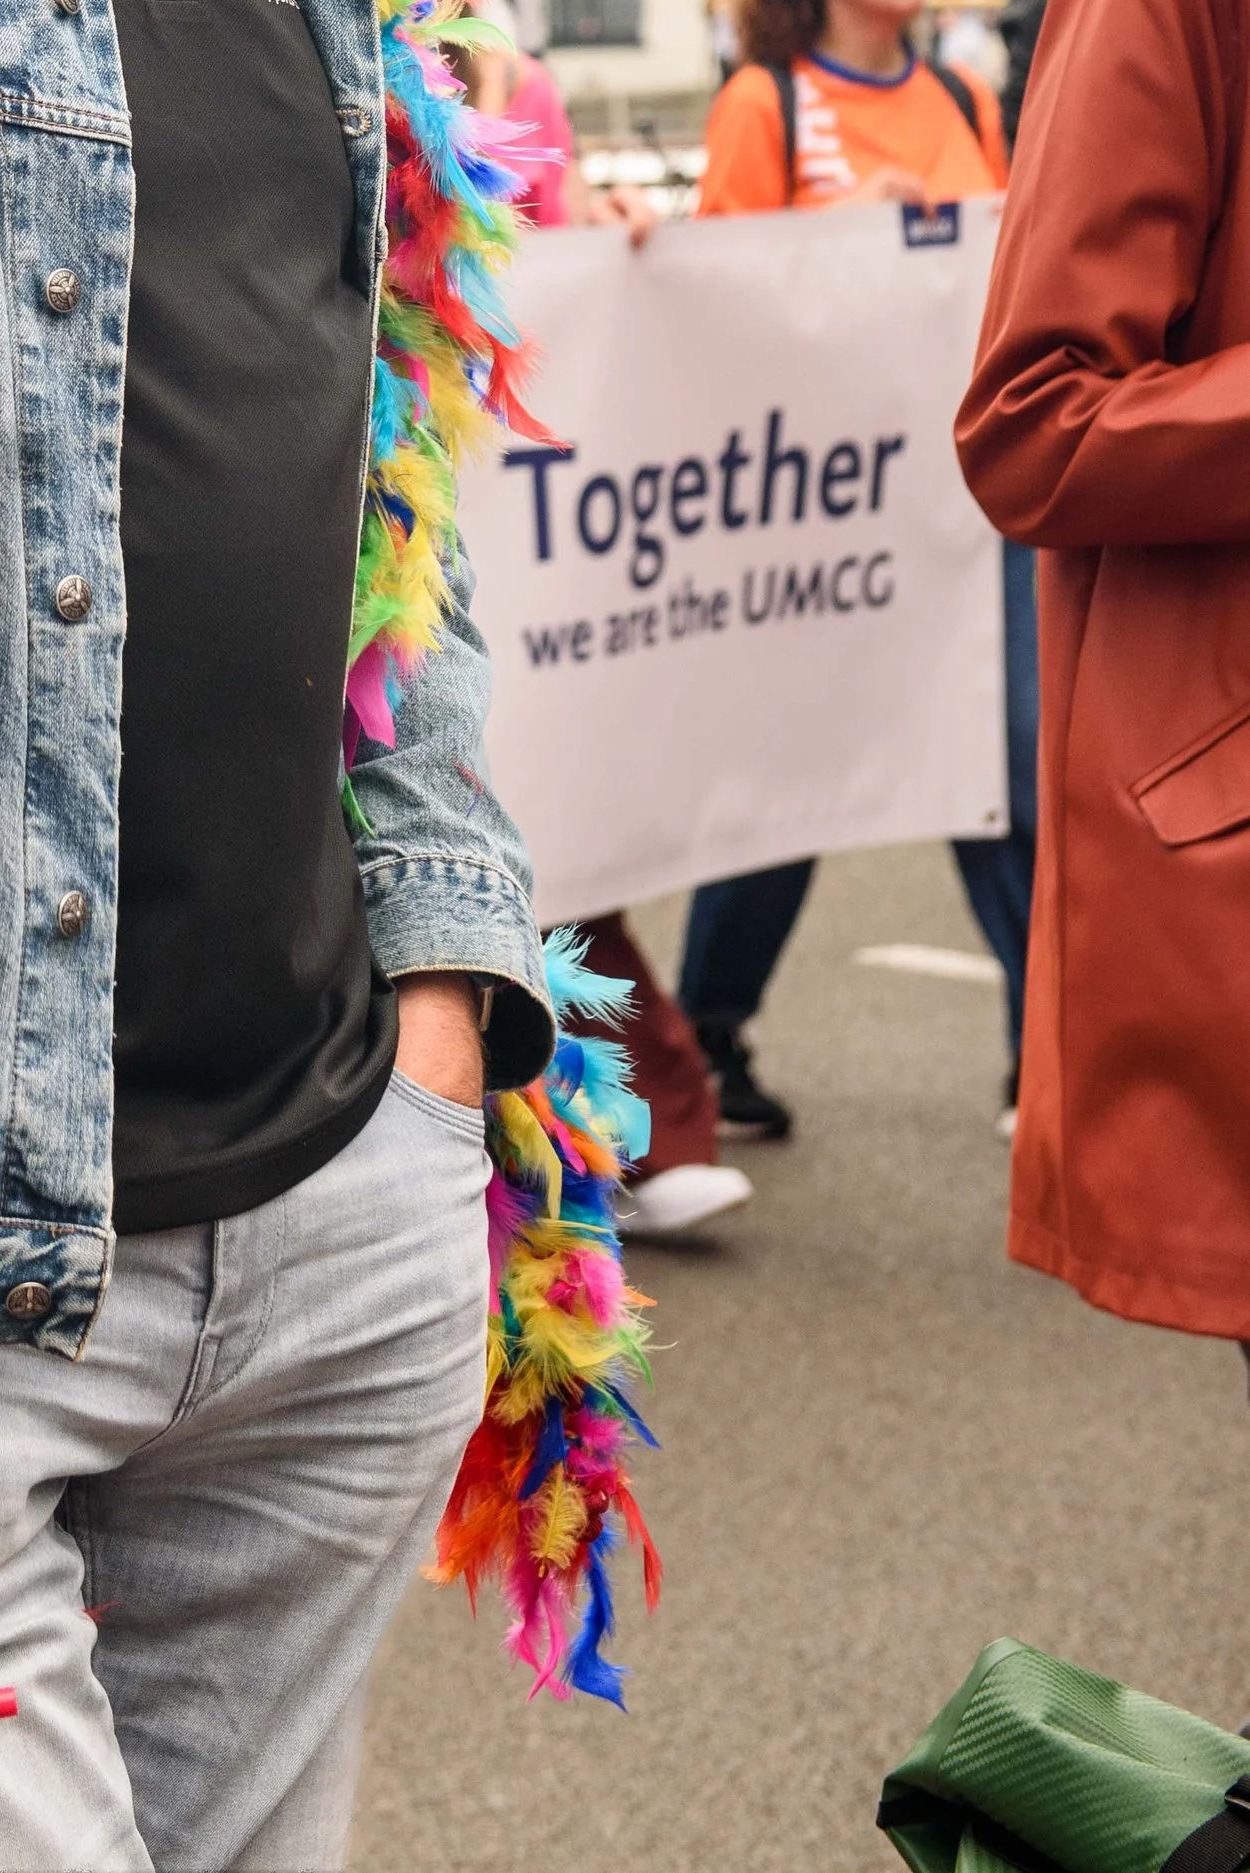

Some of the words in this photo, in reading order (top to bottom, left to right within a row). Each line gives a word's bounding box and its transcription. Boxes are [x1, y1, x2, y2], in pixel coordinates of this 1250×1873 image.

[502, 407, 906, 589] Together
[522, 616, 593, 668] we
[604, 605, 660, 657] are
[668, 577, 730, 639] the
[741, 550, 894, 624] UMCG
